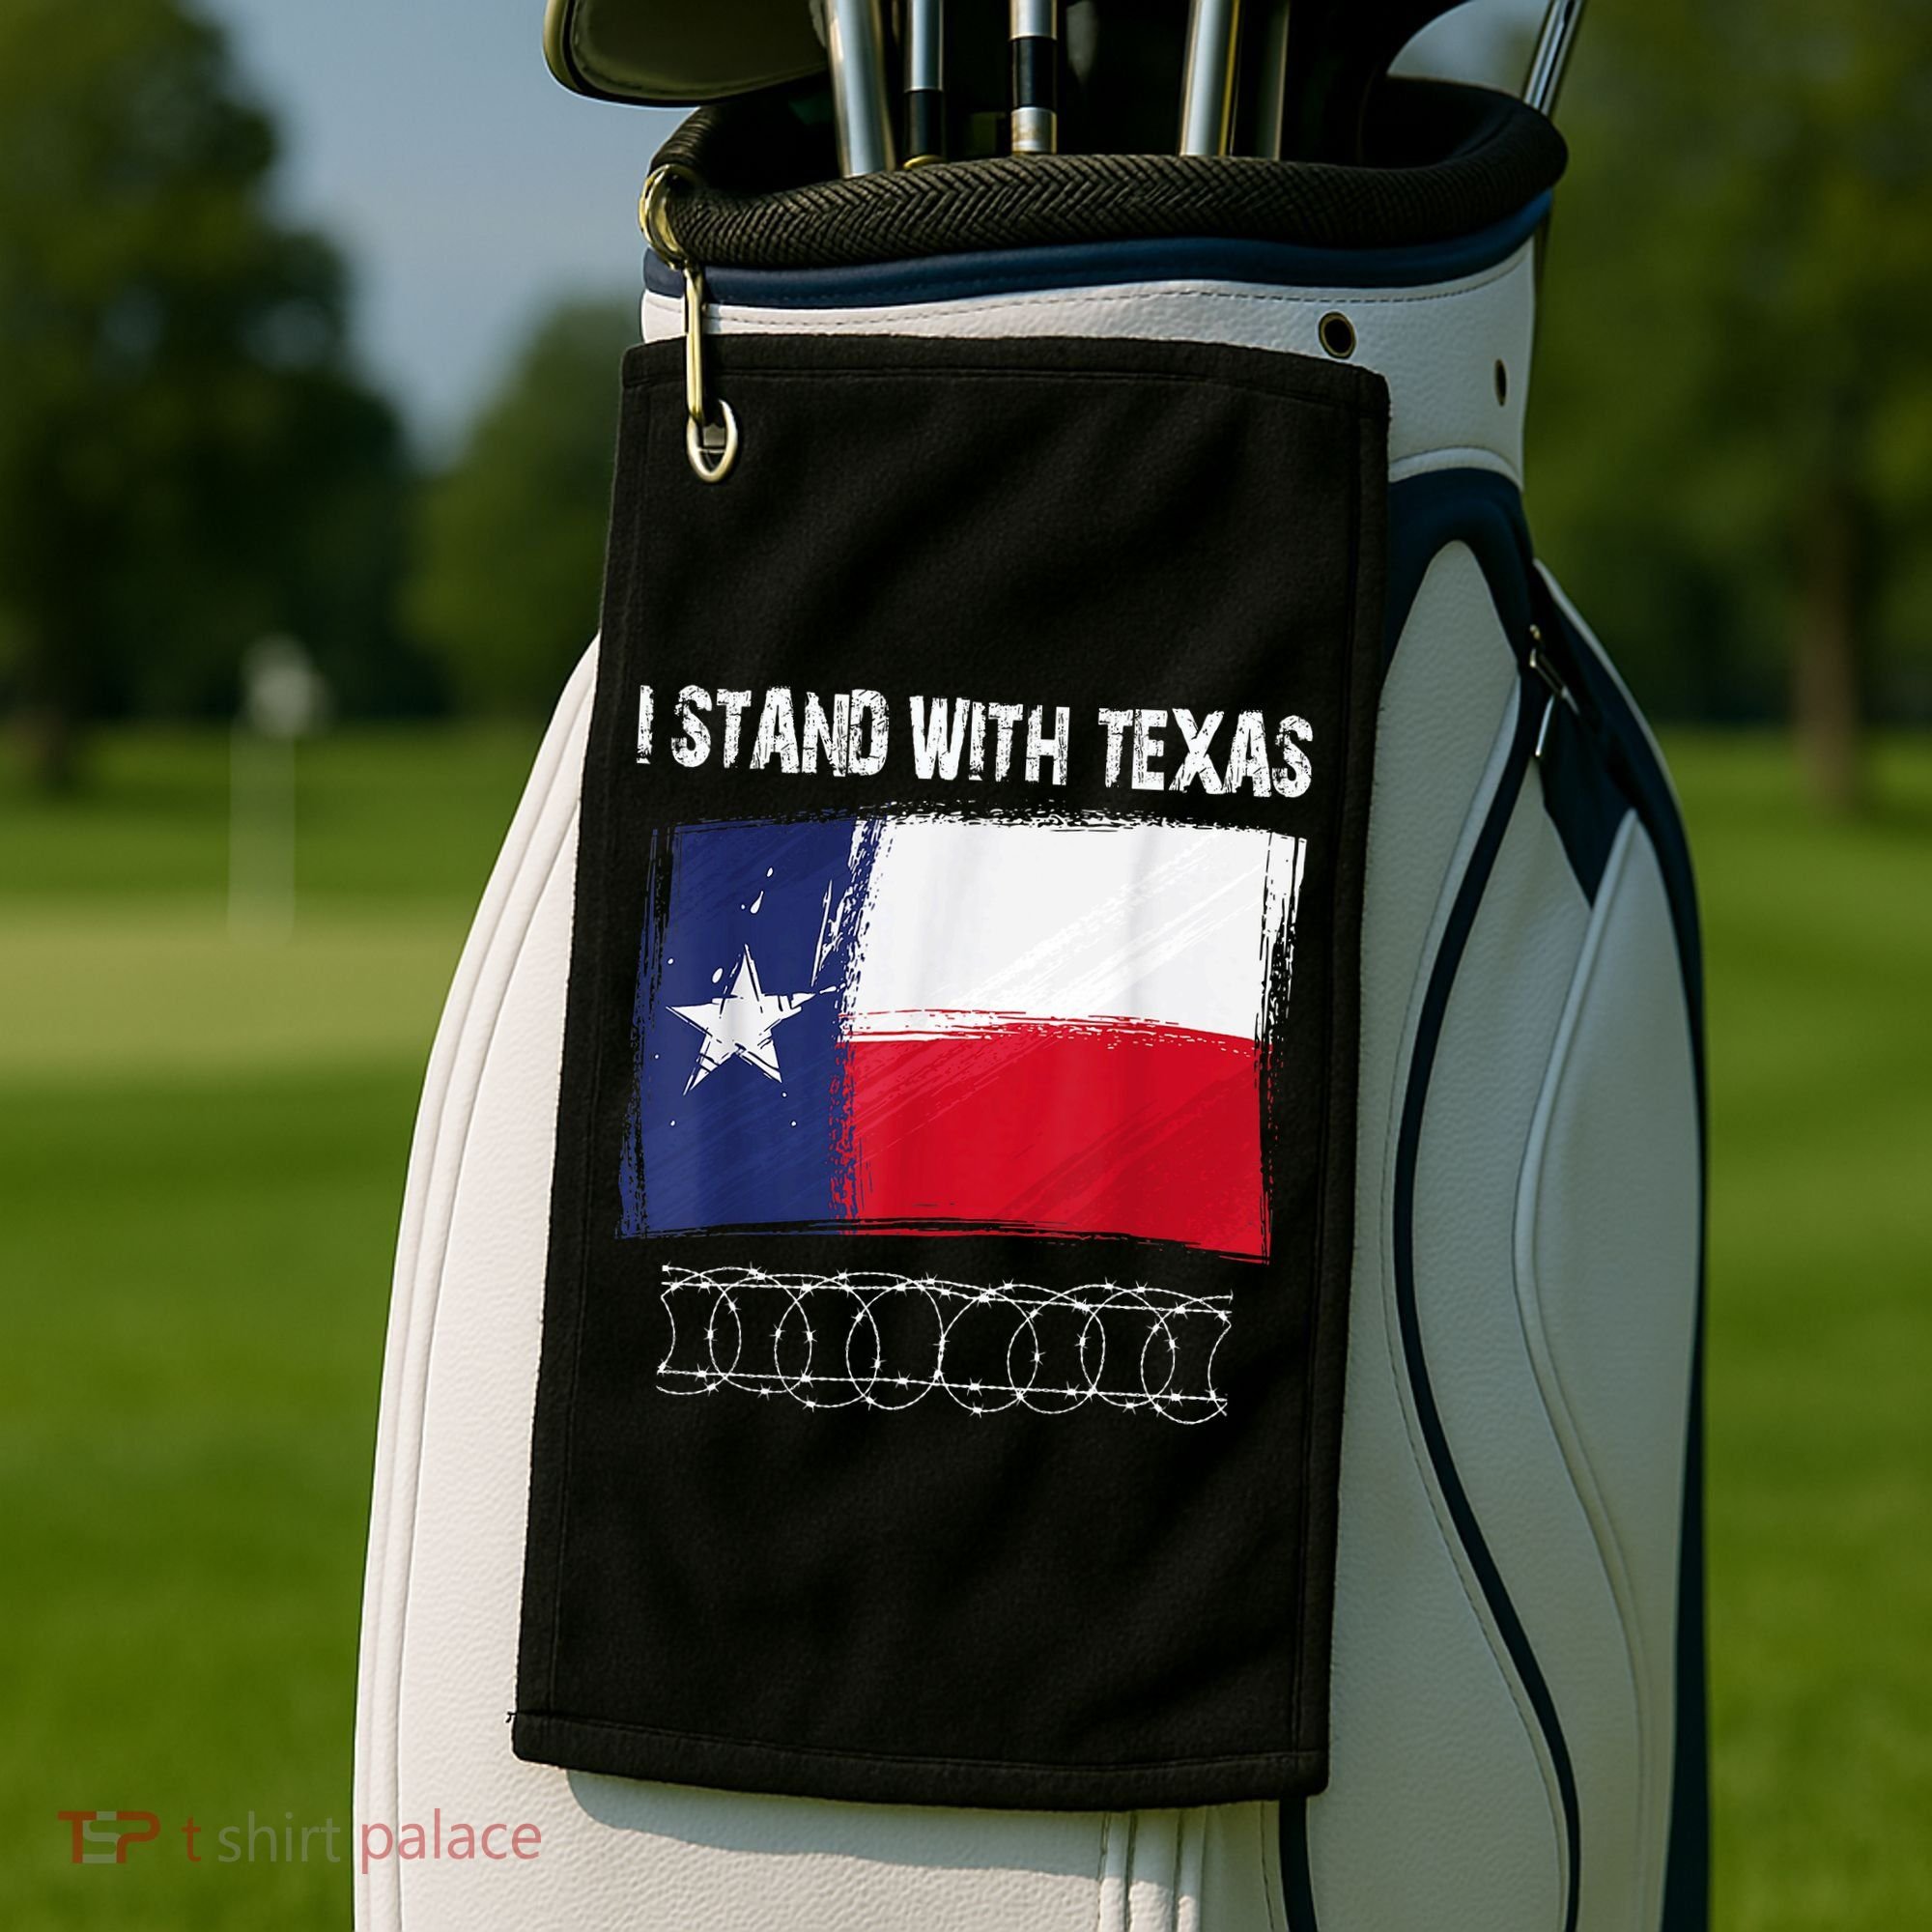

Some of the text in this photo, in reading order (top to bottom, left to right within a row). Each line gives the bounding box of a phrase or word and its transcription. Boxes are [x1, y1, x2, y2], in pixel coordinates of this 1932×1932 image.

[637, 684, 1314, 798] I STAND WITH TEXAS
